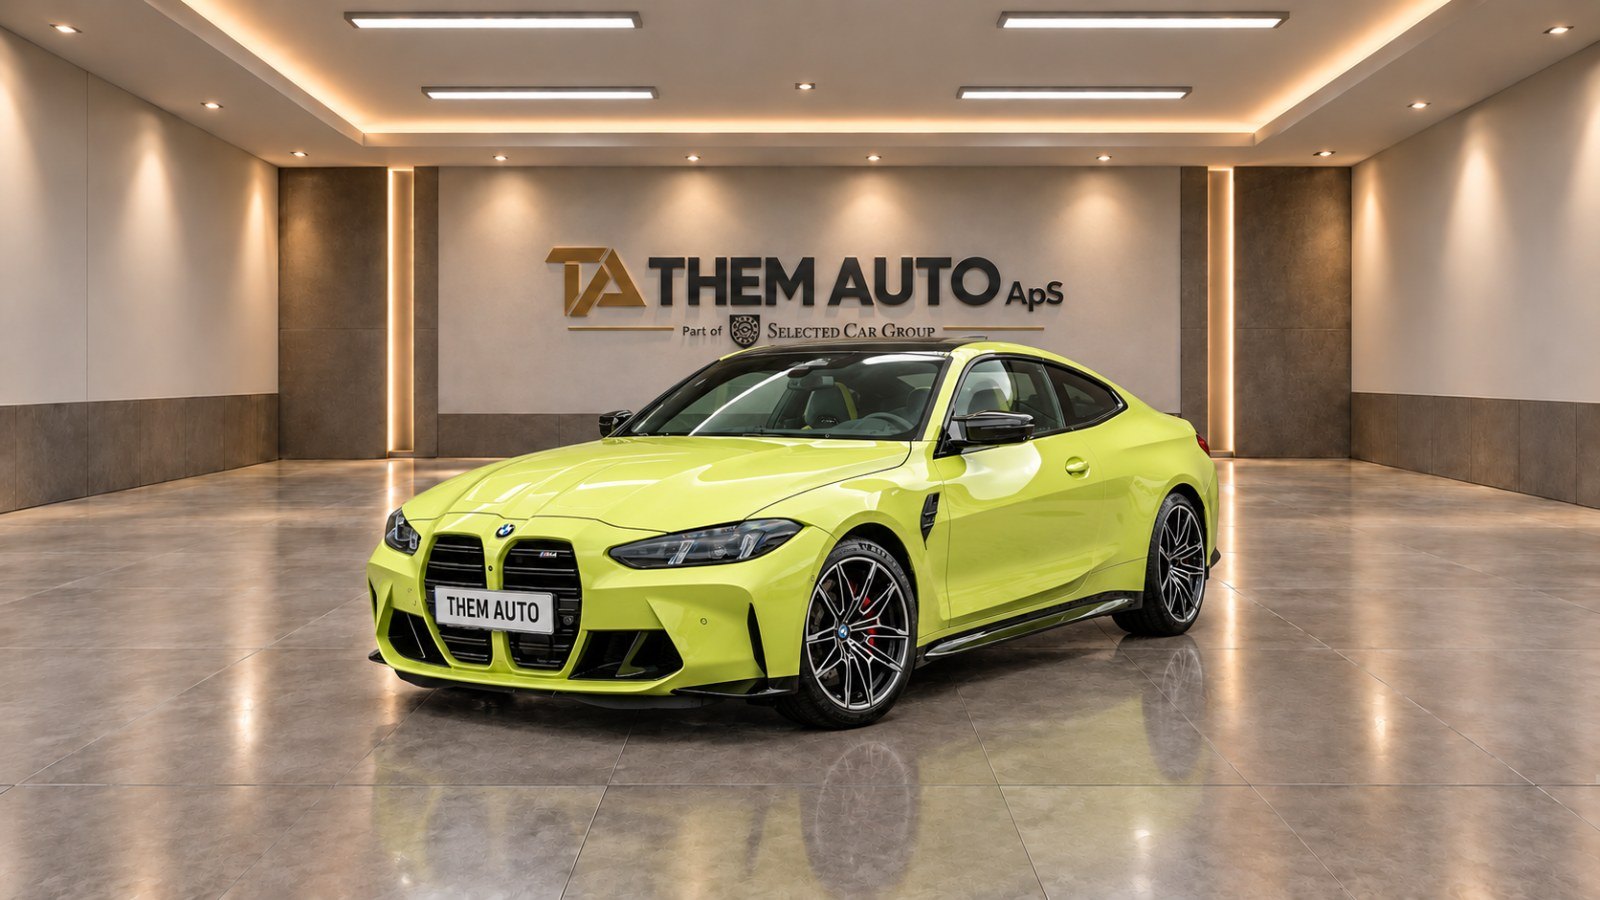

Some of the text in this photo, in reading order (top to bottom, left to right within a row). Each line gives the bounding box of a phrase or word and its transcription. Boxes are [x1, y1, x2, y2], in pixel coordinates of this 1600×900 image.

[648, 256, 1064, 312] THEM AUTO ApS
[682, 322, 936, 339] Part of SELECTED CAR GROUP
[447, 595, 540, 624] THEM AUTO
